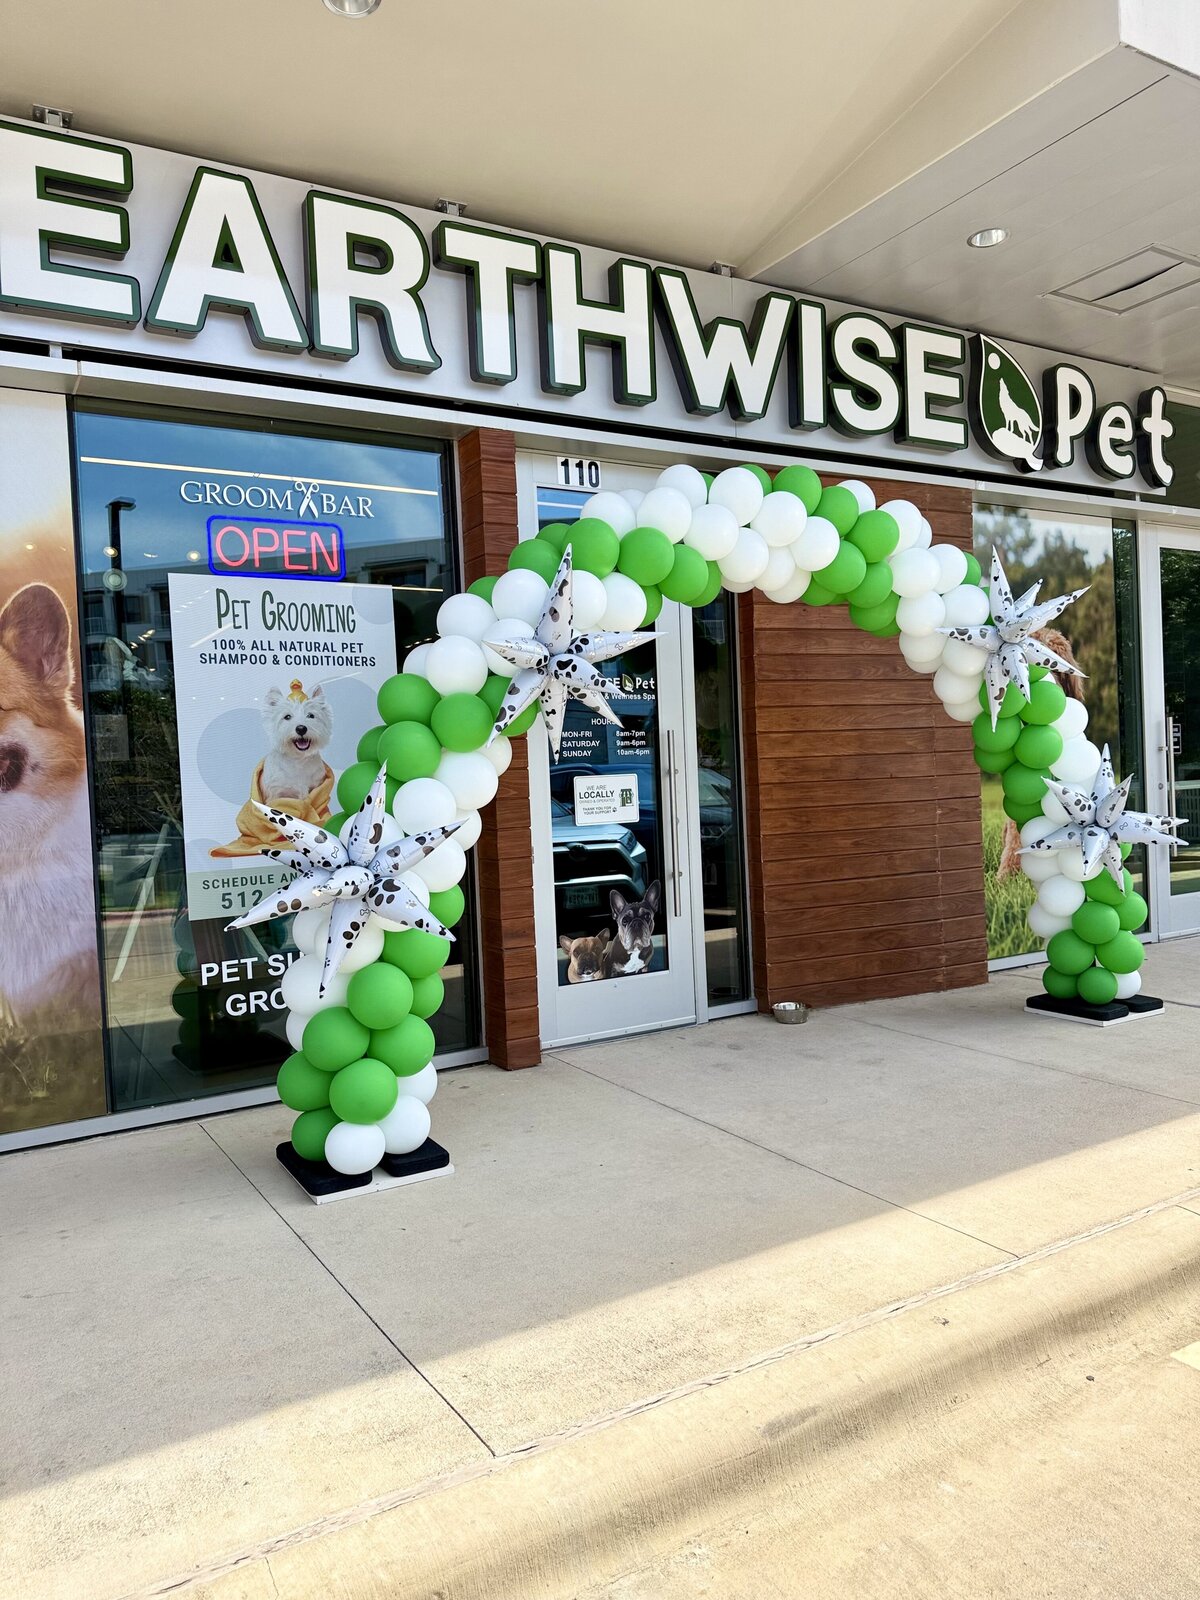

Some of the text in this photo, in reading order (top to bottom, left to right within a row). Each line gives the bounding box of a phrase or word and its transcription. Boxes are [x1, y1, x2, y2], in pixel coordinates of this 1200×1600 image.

[0, 120, 1175, 489] EARTHWISE Pet
[560, 458, 600, 488] 110
[180, 480, 375, 518] GROOM BAR
[215, 525, 339, 572] OPEN
[211, 639, 364, 653] 100% ALL NATURAL PET
[200, 653, 376, 667] SHAMPOO & CONDITIONERS
[636, 677, 655, 689] Pet
[642, 692, 656, 702] Spa
[562, 730, 646, 739] MON-FRI 8am-7pm
[562, 740, 600, 748] SATURDAY
[617, 749, 650, 757] 10am-6pm
[578, 790, 615, 799] LOCALLY
[202, 874, 274, 890] SCHEDULE
[200, 956, 259, 986] PET
